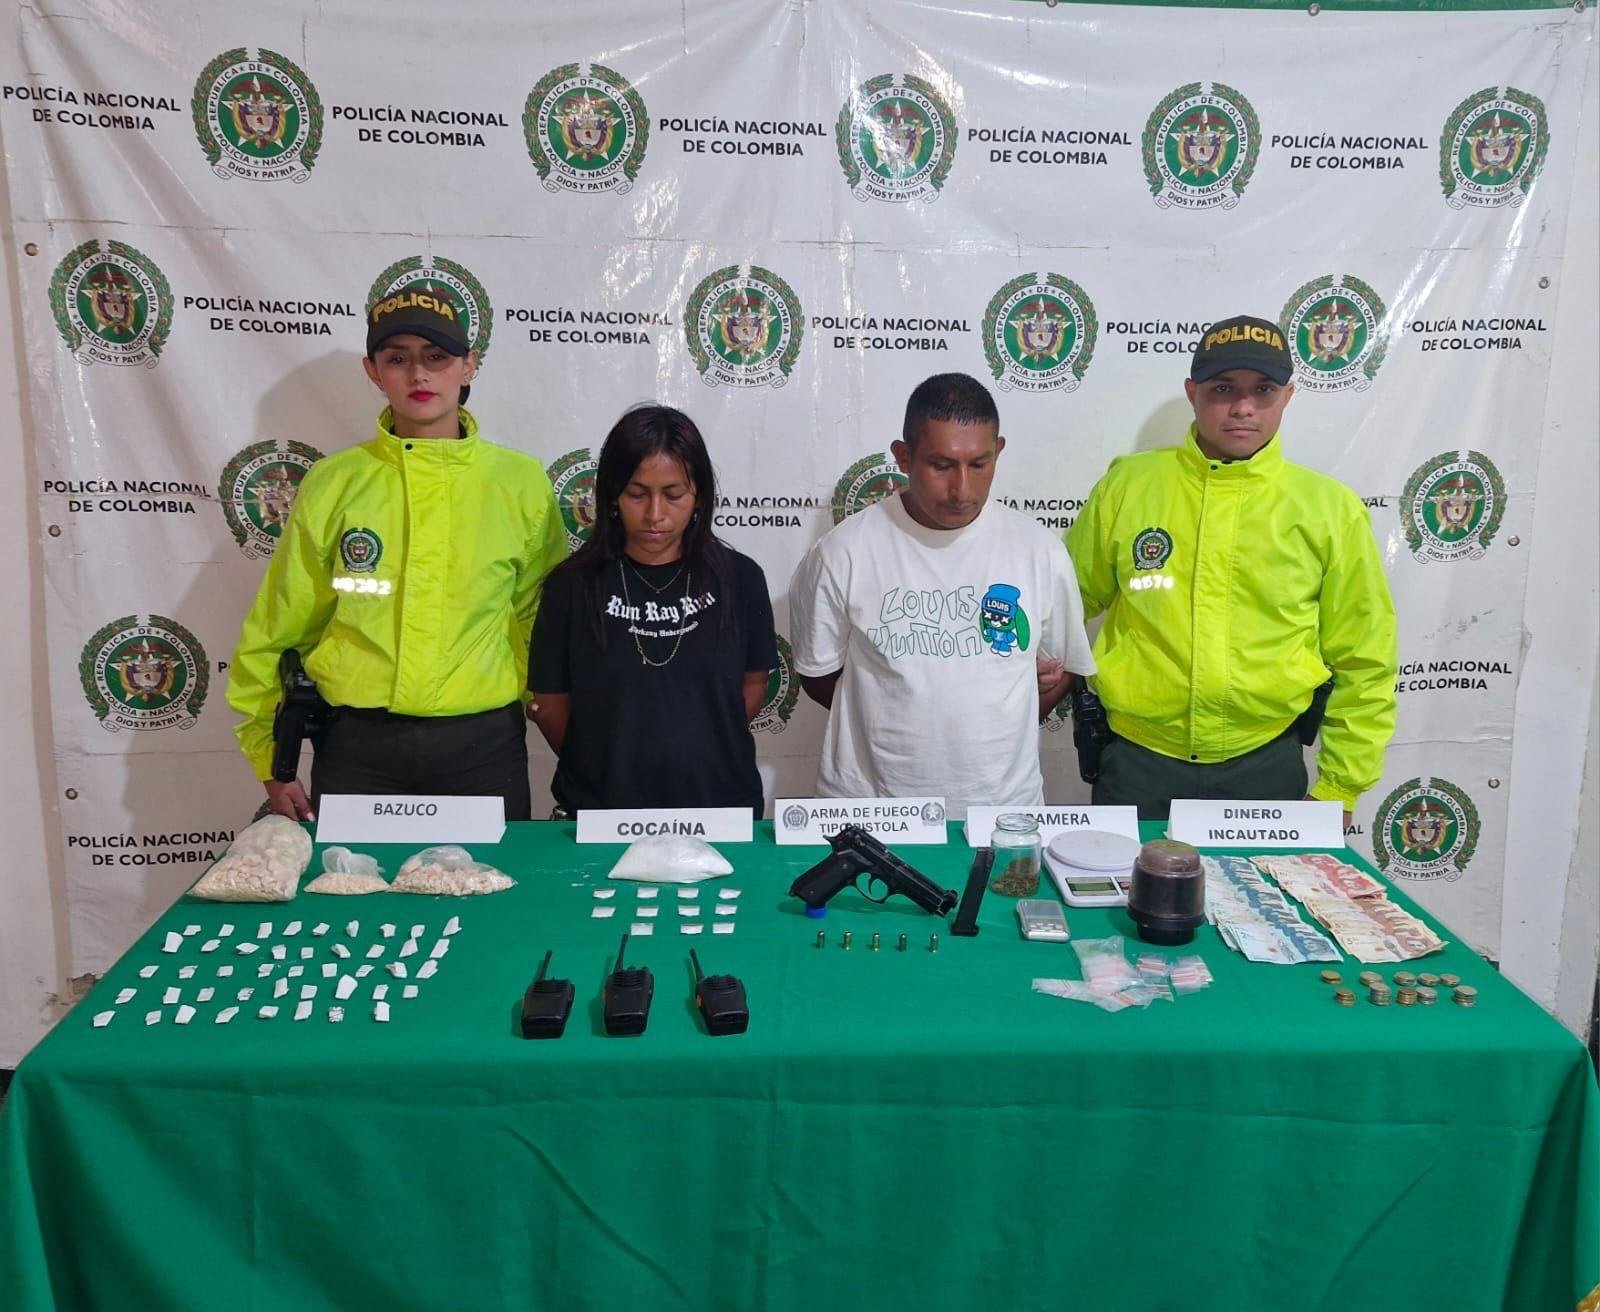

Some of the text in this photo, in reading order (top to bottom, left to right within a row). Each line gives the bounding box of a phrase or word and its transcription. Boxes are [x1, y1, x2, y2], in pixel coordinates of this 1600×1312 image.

[3, 86, 181, 111] POLICÍA NACIONAL
[275, 72, 308, 125] COLOMBIA
[32, 109, 155, 130] DE COLOMBIA
[332, 105, 508, 126] POLICÍA NACIONAL
[660, 116, 827, 136] POLICÍA NACIONAL
[1223, 103, 1247, 154] COLOMBIA
[359, 128, 485, 146] DE COLOMBIA
[968, 126, 1132, 145] POLICÍA NACIONAL
[1272, 133, 1428, 149] POLICÍA NACIONAL
[262, 135, 305, 166] NACIONAL
[683, 140, 803, 156] DE COLOMBIA
[588, 148, 630, 178] NACIONAL
[990, 150, 1107, 164] DE COLOMBIA
[1291, 156, 1404, 169] DE COLOMBIA
[263, 164, 295, 178] PATRIA
[1198, 164, 1240, 194] NACIONAL
[588, 176, 619, 190] PATRIA
[1197, 192, 1227, 206] PATRIA
[124, 262, 156, 313] COLOMBIA
[184, 296, 356, 316] POLICÍA NACIONAL
[372, 292, 454, 323] POLICIA
[447, 277, 478, 327] COLOMBIA
[762, 286, 790, 334] COLOMBIA
[506, 307, 672, 325] POLICÍA NACIONAL
[812, 314, 971, 332] POLICÍA NACIONAL
[1059, 292, 1084, 340] COLOMBIA
[1462, 319, 1546, 330] NACIONAL
[210, 318, 331, 335] DE COLOMBIA
[1106, 320, 1170, 334] POLICÍA
[122, 324, 153, 351] NACIONAL
[530, 330, 650, 344] DE COLOMBIA
[834, 336, 948, 350] DE COLOMBIA
[1205, 325, 1283, 351] POLICIA
[1422, 338, 1522, 351] DE COLOMBIA
[1128, 342, 1148, 353] DE
[1039, 349, 1078, 378] NACIONAL
[745, 371, 775, 384] PATRIA
[1038, 376, 1067, 389] PATRIA
[1476, 468, 1491, 511] COLOMBIA
[69, 500, 196, 514] DE COLOMBIA
[1024, 499, 1088, 511] NACION
[714, 515, 801, 527] COLOMBIA
[1452, 521, 1485, 548] NACIONAL
[1450, 547, 1474, 559] PATRIA
[605, 595, 640, 620] Run
[645, 602, 680, 623] Ray
[880, 586, 980, 624] LOUIS
[986, 600, 1010, 612] LOUIS
[164, 633, 196, 678] COLOMBIA
[1398, 661, 1512, 676] ICÍA NACIONAL
[1409, 678, 1488, 691] COLOMBIA
[149, 687, 192, 716] NACIONAL
[150, 714, 182, 727] PATRIA
[374, 803, 437, 816] BAZUCO
[811, 806, 920, 818] ARMA DE FUEGO
[1224, 808, 1282, 819] DINERO
[1442, 795, 1465, 835] COLOMBIA
[617, 818, 706, 836] COCAÍNA
[1208, 829, 1300, 840] INCAUTADO
[68, 833, 137, 848] POLICÍA
[92, 851, 216, 866] DE COLOMBIA
[1422, 844, 1460, 868] NACIONAL
[1421, 867, 1449, 878] PATRIA
